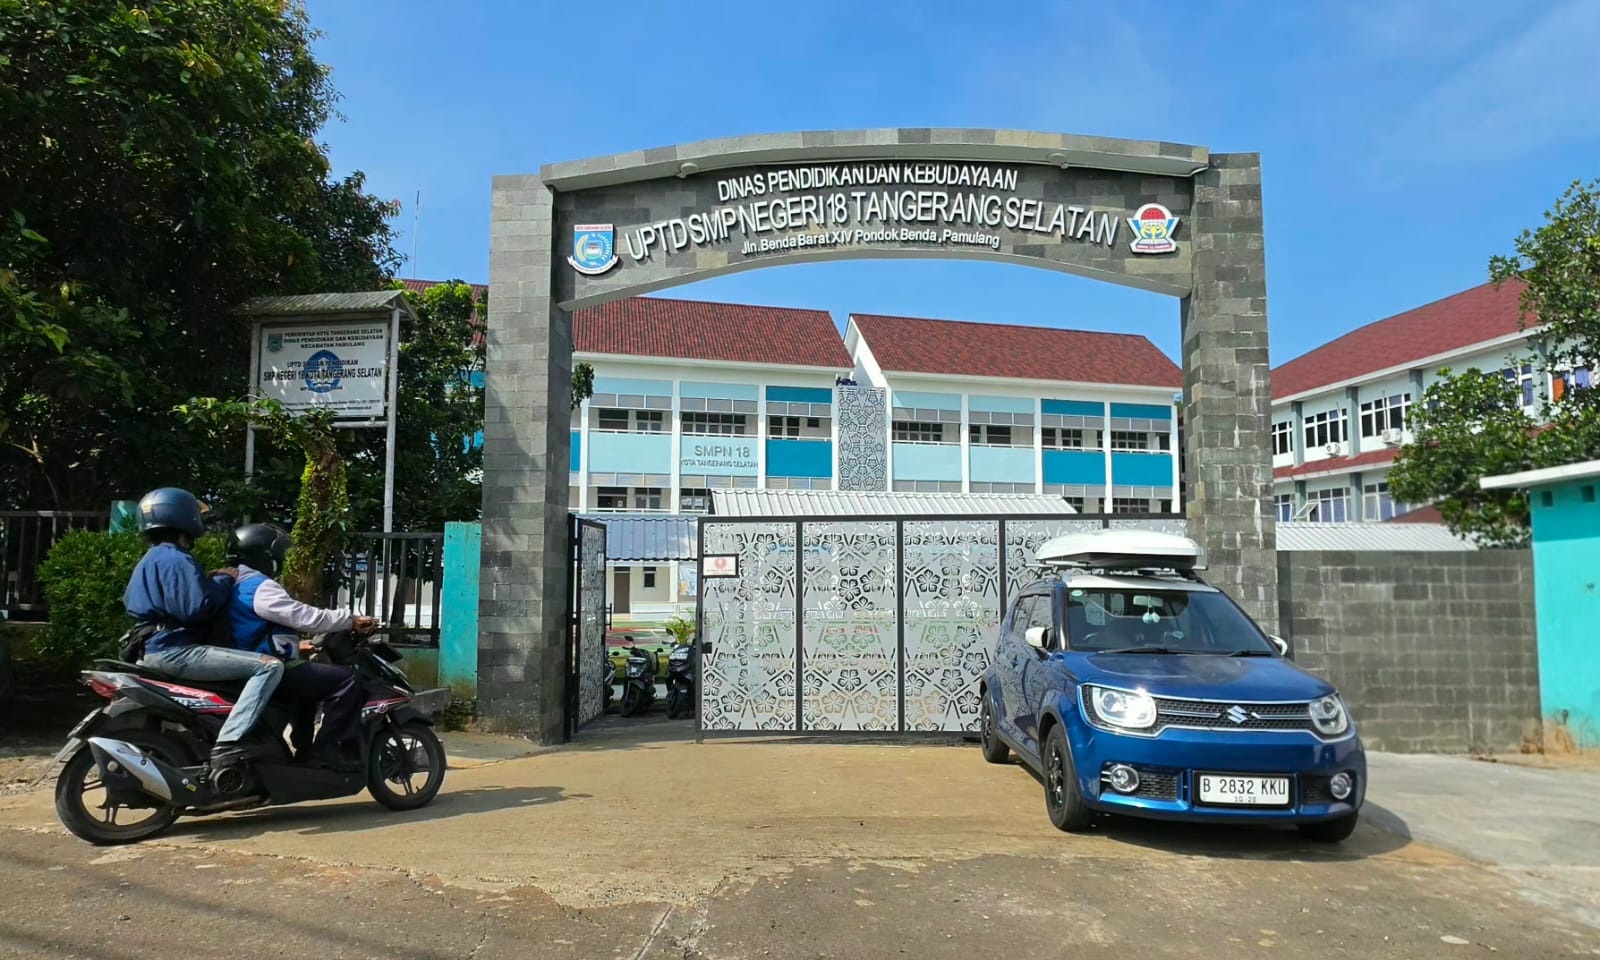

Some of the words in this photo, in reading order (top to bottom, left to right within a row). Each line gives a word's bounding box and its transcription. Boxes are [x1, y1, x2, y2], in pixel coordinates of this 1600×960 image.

[717, 173, 766, 201] DINAS
[767, 164, 864, 193] PENDIDIKAN
[866, 163, 900, 184] DAN
[903, 163, 1018, 191] KEBUDAYAAN
[625, 218, 688, 260] UPTD
[688, 207, 737, 244] SMP
[738, 194, 825, 234] NEGERI
[826, 192, 848, 224] 18
[851, 190, 1001, 226] TANGERANG
[1003, 197, 1119, 246] SELATAN
[797, 231, 830, 246] Barat
[831, 230, 853, 243] XIV
[855, 226, 899, 242] Pondok
[357, 367, 382, 378] SELATAN
[694, 445, 732, 457] SMPN
[736, 446, 750, 458] 18
[1203, 778, 1211, 793] B
[1219, 778, 1255, 795] 2832
[1261, 779, 1286, 796] KKU
